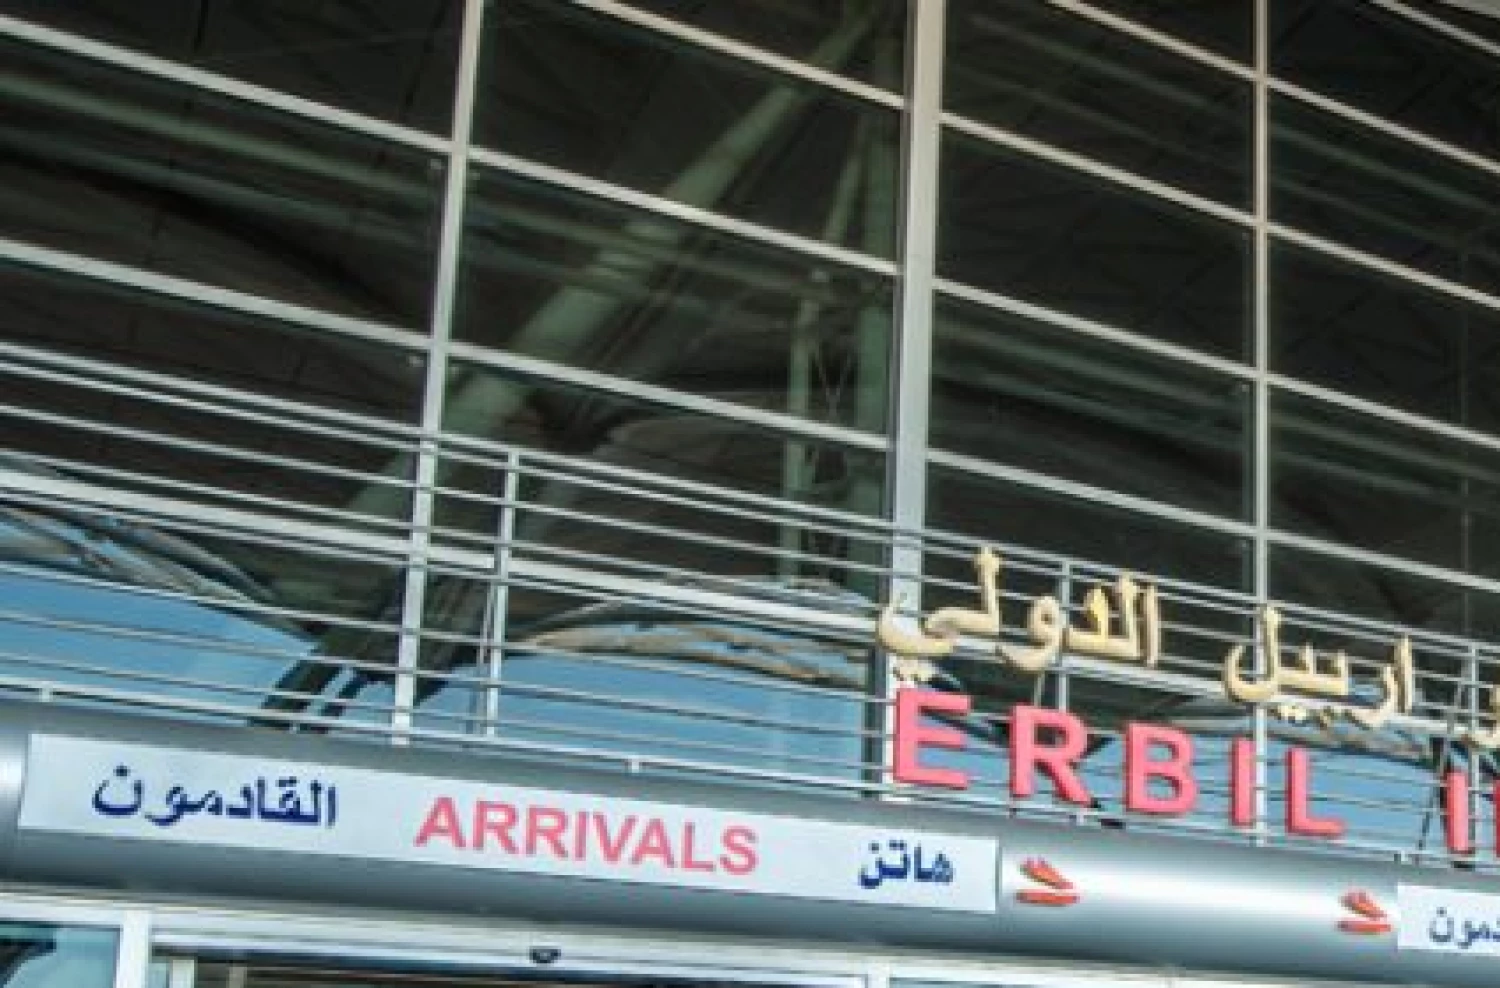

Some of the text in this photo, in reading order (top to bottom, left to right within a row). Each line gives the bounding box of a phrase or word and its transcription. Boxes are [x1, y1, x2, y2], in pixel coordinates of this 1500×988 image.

[880, 545, 1160, 683] الدولي
[90, 764, 338, 829] القادمون
[892, 688, 1346, 838] ERBIL
[414, 797, 759, 876] ARRIVALS
[858, 839, 954, 889] هاتن
